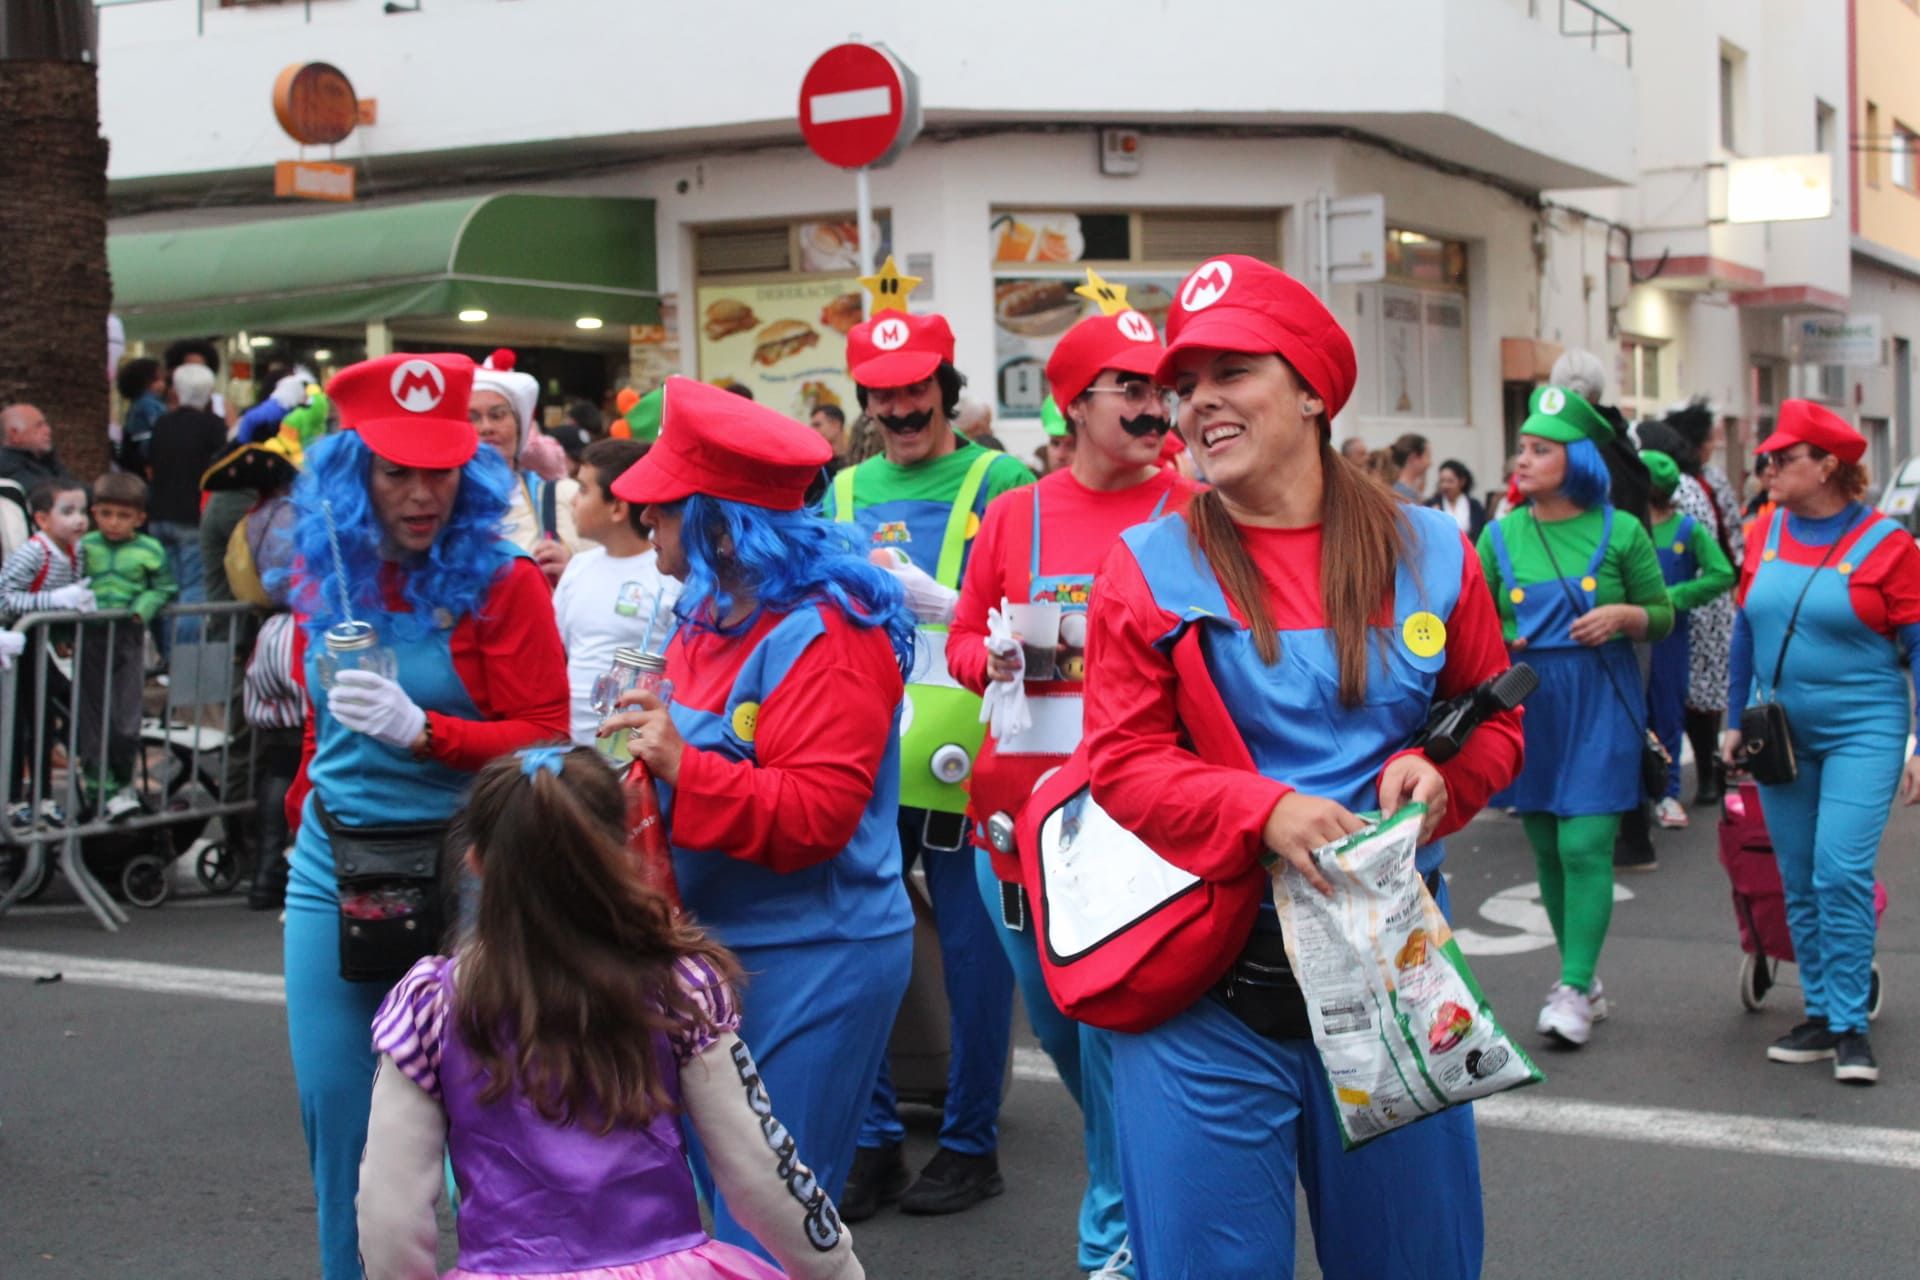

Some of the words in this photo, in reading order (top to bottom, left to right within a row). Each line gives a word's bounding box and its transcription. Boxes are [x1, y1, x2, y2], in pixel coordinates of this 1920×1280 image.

[1184, 266, 1226, 307] M
[881, 322, 899, 345] M
[1124, 316, 1149, 337] M
[396, 368, 442, 402] M
